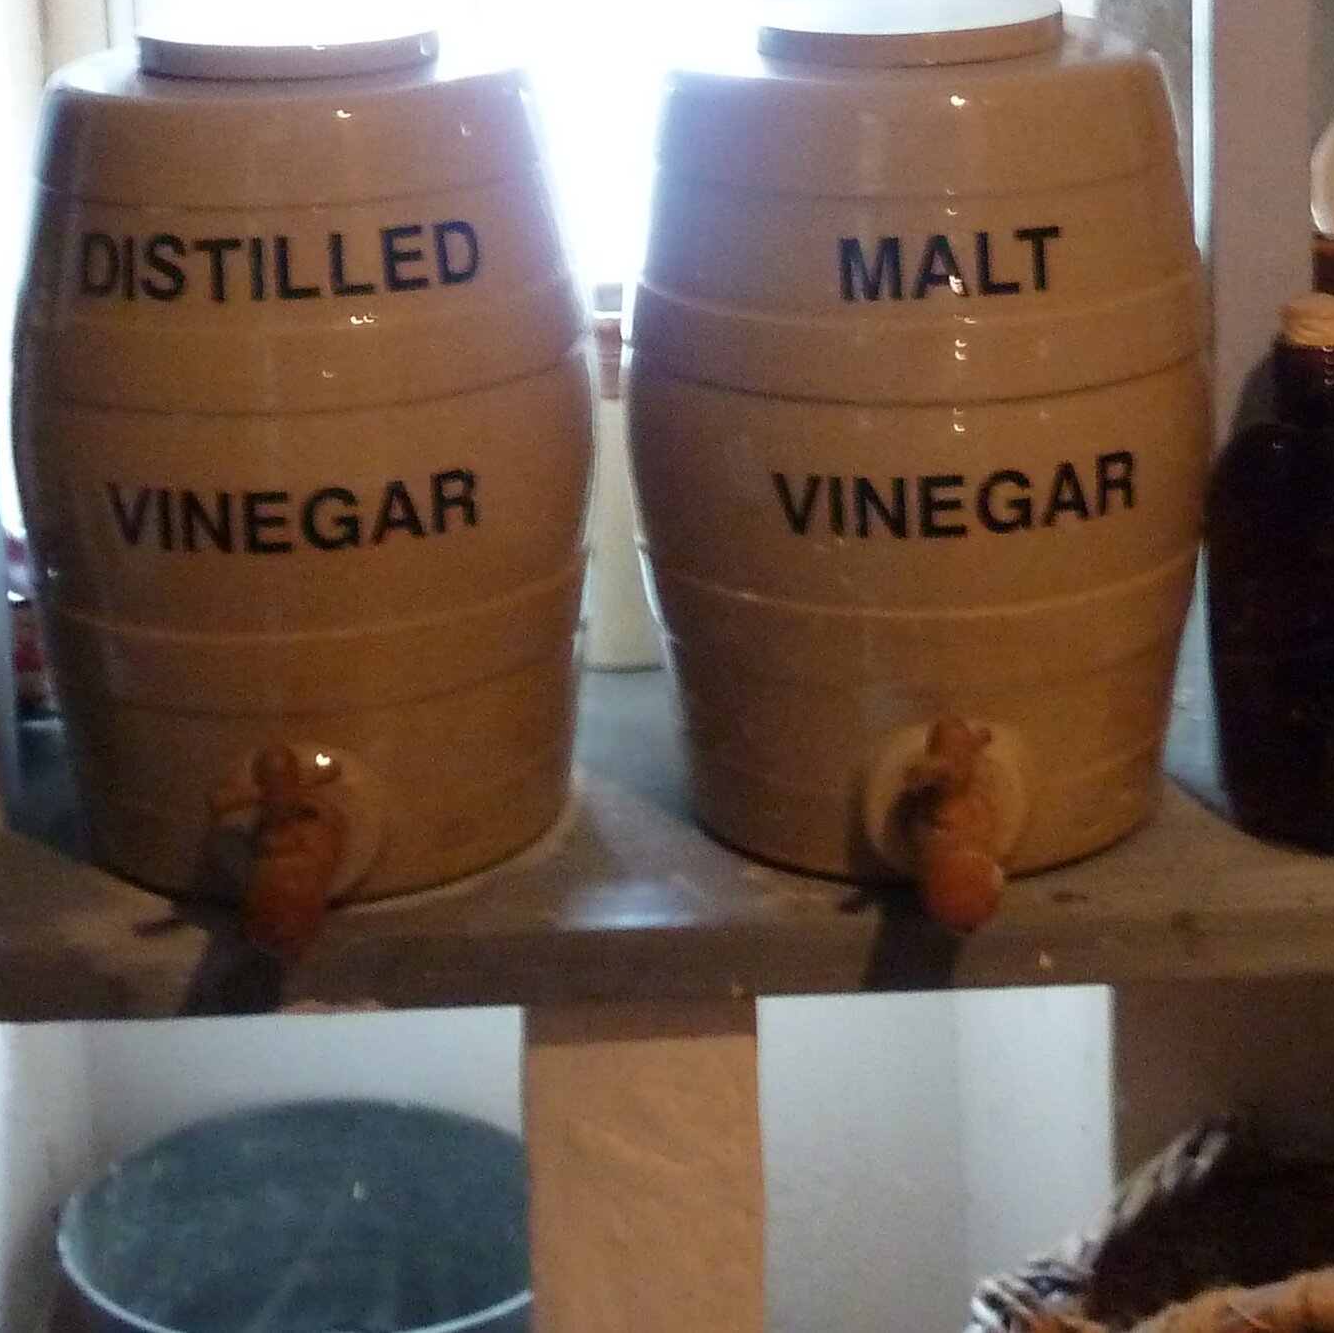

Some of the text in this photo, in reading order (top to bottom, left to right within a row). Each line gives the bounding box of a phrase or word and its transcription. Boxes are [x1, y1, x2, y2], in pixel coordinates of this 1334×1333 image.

[80, 220, 480, 303] DISTILLED
[838, 226, 1061, 301] MALT
[107, 468, 480, 554] VINEGAR
[771, 450, 1137, 539] VINEGAR
